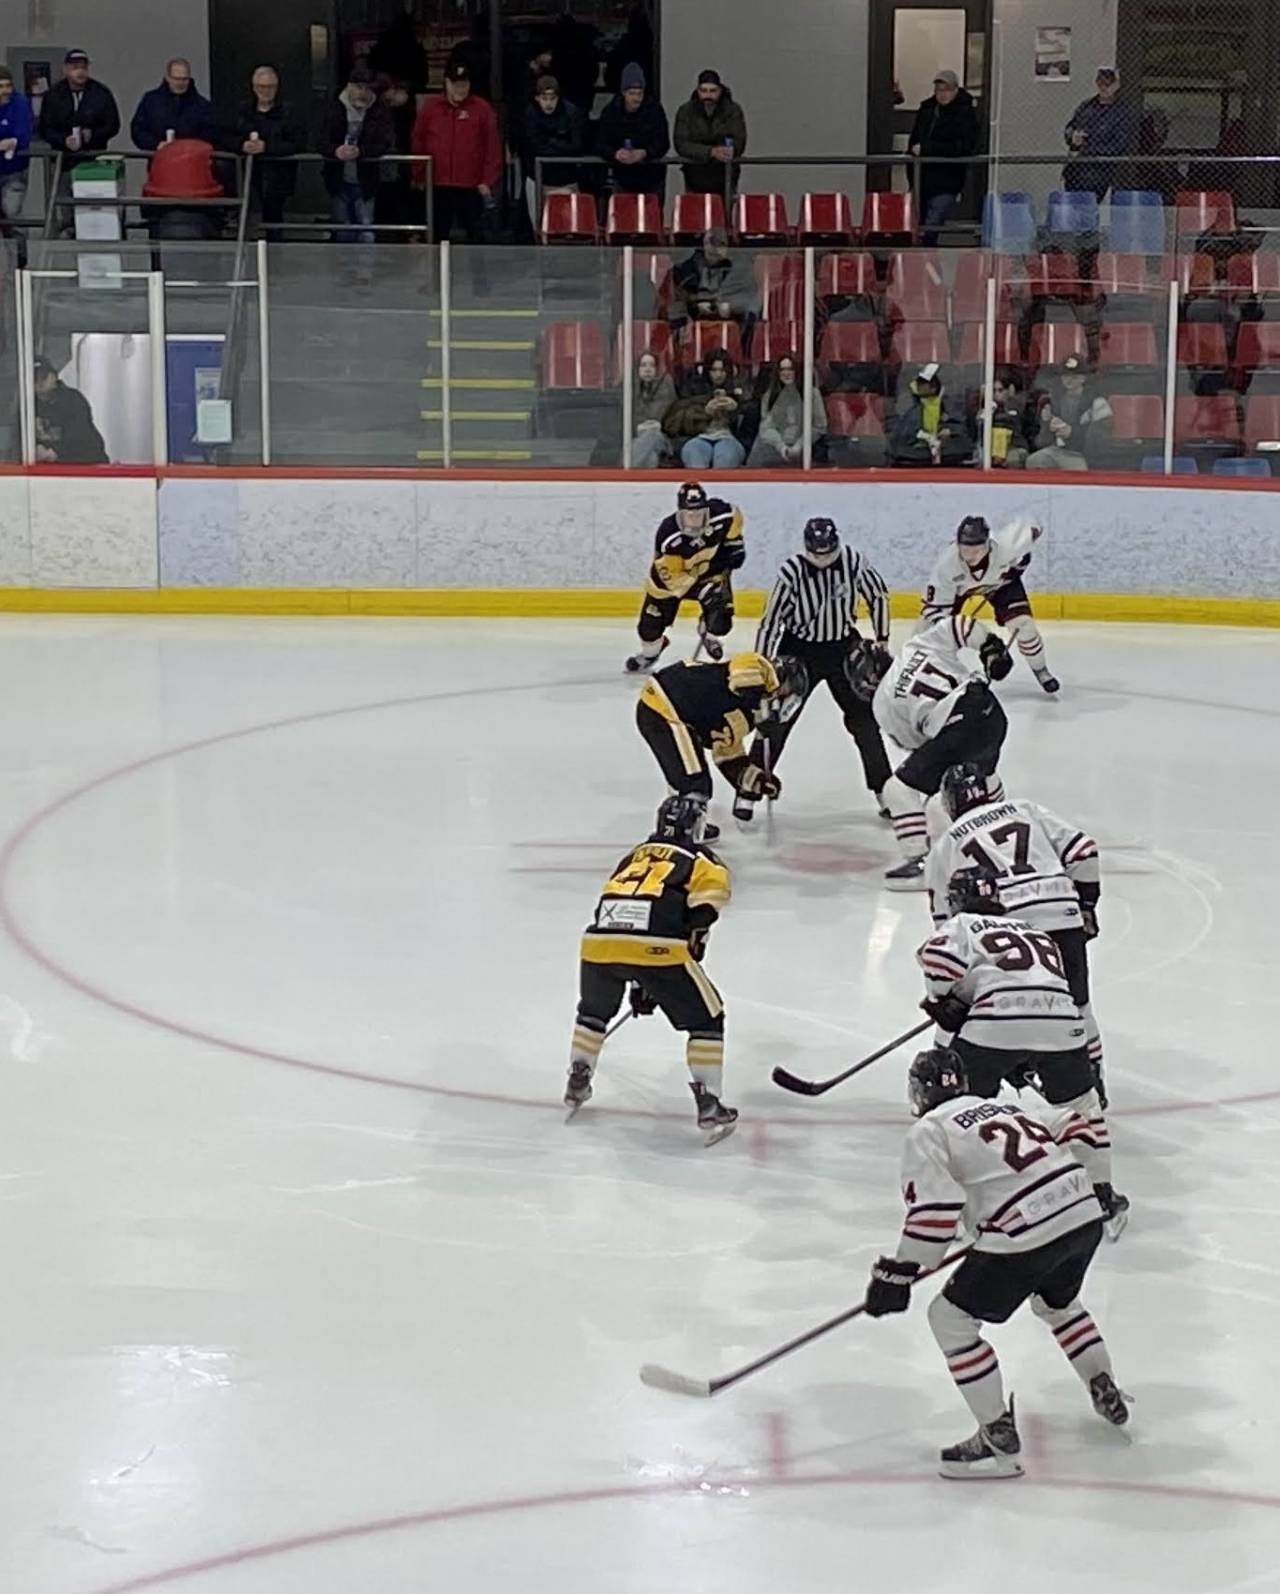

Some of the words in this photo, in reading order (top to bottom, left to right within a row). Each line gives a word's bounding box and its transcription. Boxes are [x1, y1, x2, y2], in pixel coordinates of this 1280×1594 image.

[950, 803, 1018, 841] NUTBROWN
[960, 821, 1037, 879] 17
[980, 931, 1066, 979] 98
[979, 1115, 1056, 1174] 24
